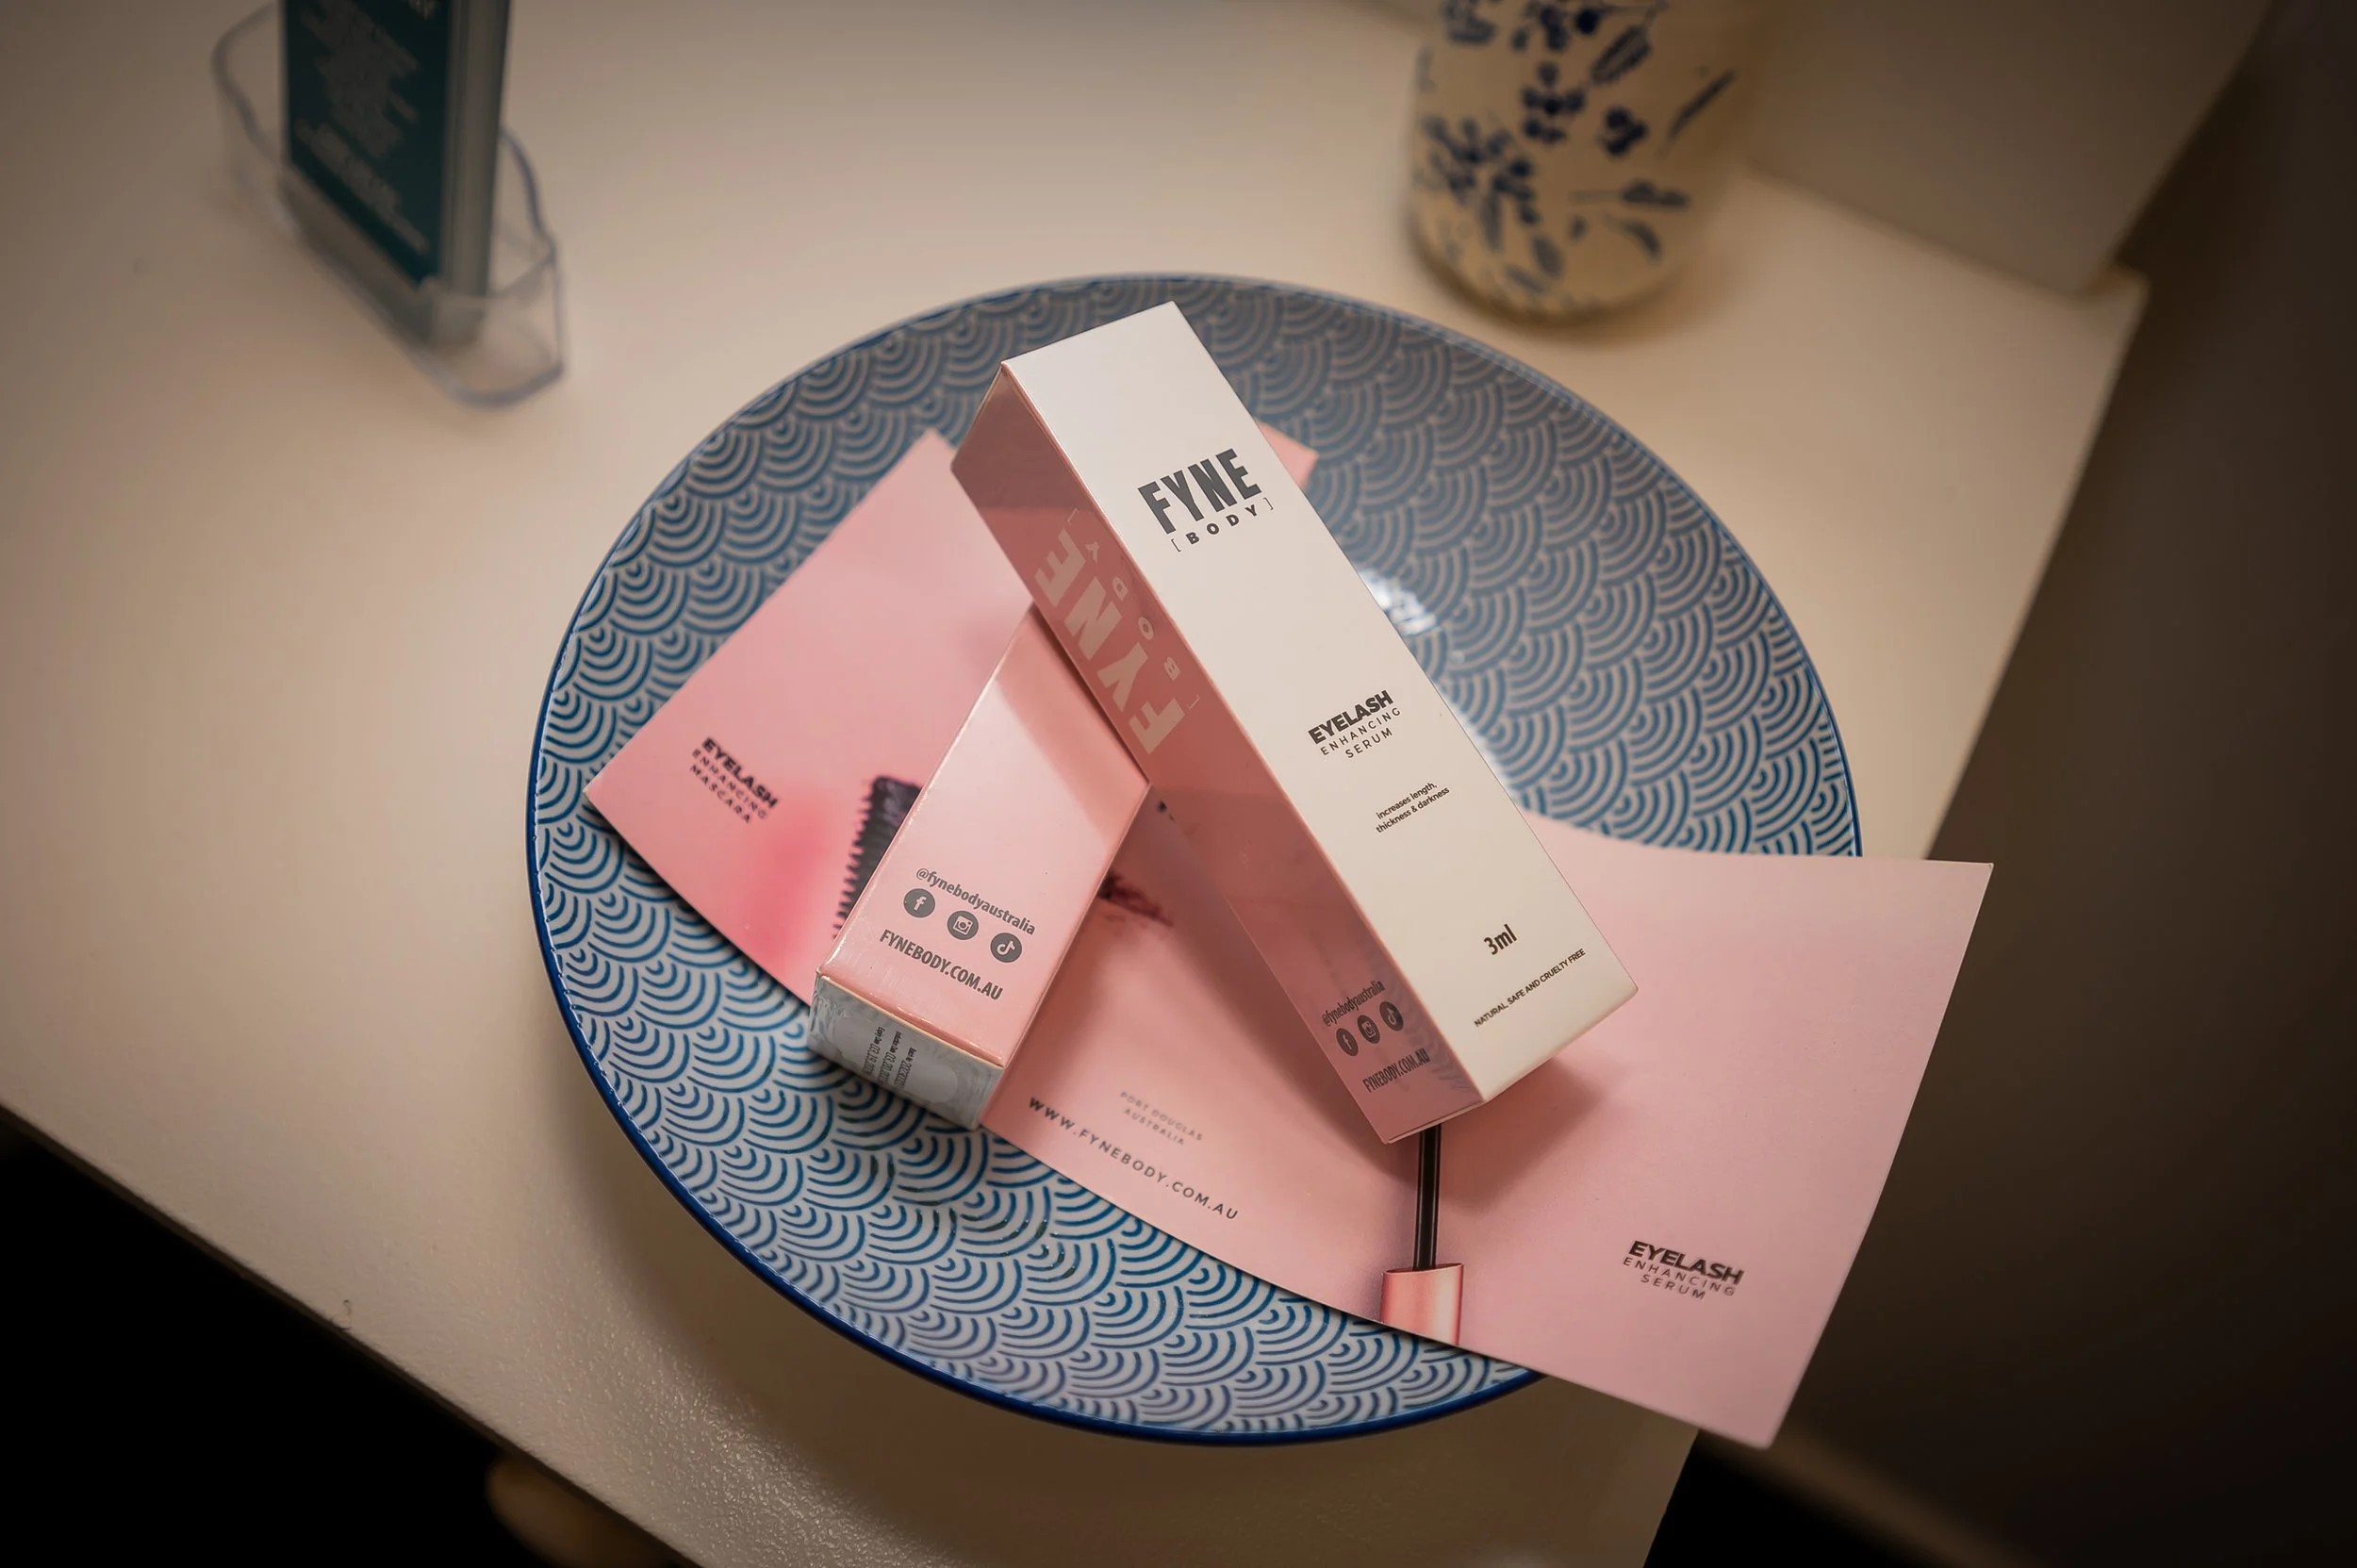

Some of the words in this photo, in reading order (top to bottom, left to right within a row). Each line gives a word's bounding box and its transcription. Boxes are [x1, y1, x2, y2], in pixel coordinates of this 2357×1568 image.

[1137, 448, 1261, 535] FYNE
[1035, 528, 1185, 754] FYNE
[1308, 690, 1393, 745] EYELASH
[1320, 707, 1401, 755] ENHANCING
[1345, 727, 1393, 758] SERUM
[689, 764, 751, 823] MASCARA
[692, 749, 767, 819] ENHANCING
[701, 736, 779, 809] EYELASH
[1376, 797, 1411, 819] increases
[1409, 783, 1437, 800] length,
[1376, 810, 1412, 834] thickness
[1417, 787, 1450, 809] darkness
[915, 867, 1036, 935] @fynebodyaustralia
[1483, 923, 1518, 955] 3ml
[879, 929, 1003, 1000] FYNEBODY.COM.AU
[1507, 989, 1525, 1005] SAFE
[1525, 979, 1541, 993] AND
[1540, 959, 1569, 982] CRUELTY
[1567, 948, 1586, 964] FREE
[1321, 980, 1386, 1027] @fynebodyaustralia
[1362, 1048, 1430, 1093] FYNEBODY.COM.AU
[1120, 1091, 1149, 1111] PORT
[1151, 1109, 1203, 1141] DOUGLAS
[1124, 1108, 1184, 1146] AUSTRALIA
[1029, 1097, 1239, 1220] WWW.FYNEBODY.COM.AU
[1624, 1257, 1735, 1296] ENHANCING
[1628, 1240, 1745, 1286] EYELASH
[1640, 1274, 1706, 1301] SERUM
